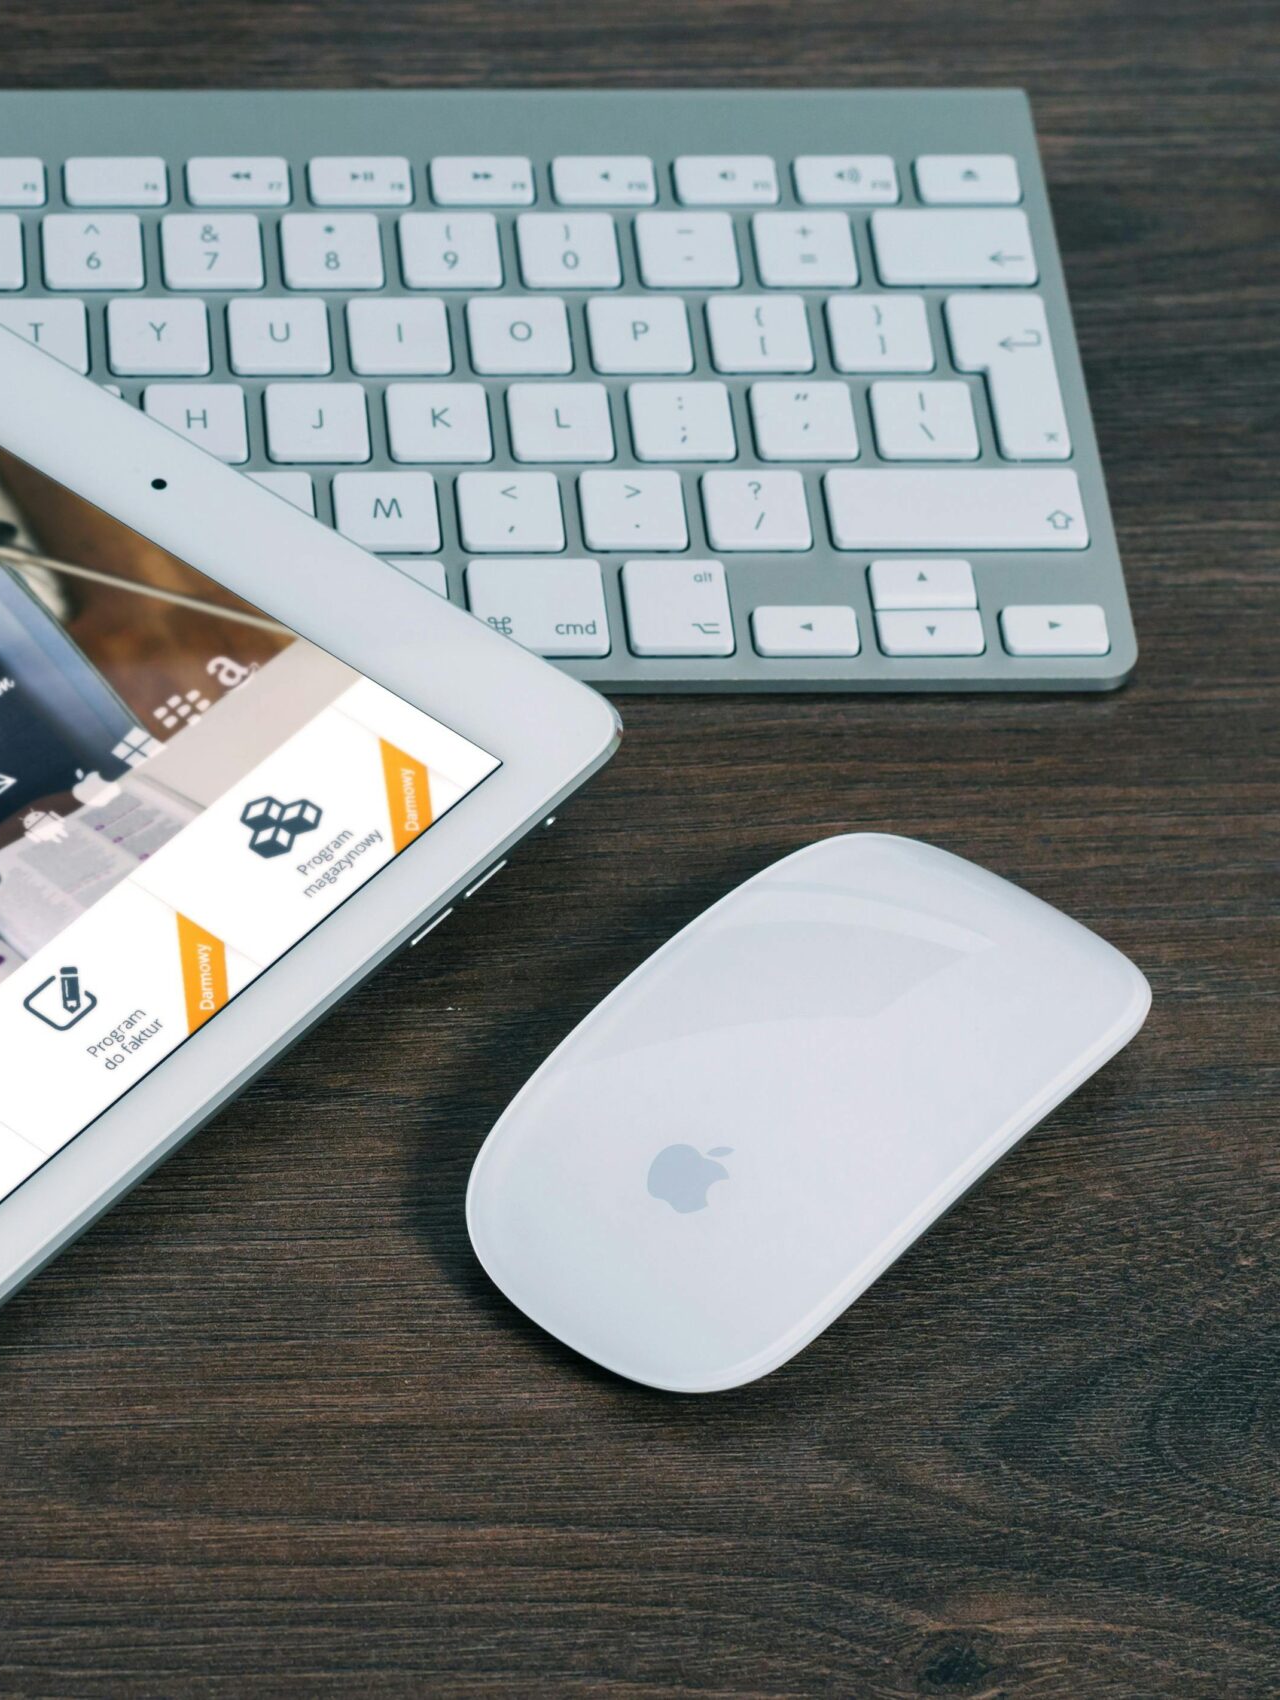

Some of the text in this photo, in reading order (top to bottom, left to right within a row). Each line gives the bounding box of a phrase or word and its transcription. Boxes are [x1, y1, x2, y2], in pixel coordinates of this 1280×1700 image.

[200, 225, 219, 243] &
[86, 252, 101, 269] 6
[204, 252, 219, 270] 7
[325, 251, 340, 270] 8
[443, 251, 458, 269] 9
[562, 250, 579, 270] 0
[29, 323, 43, 342] T
[149, 322, 166, 341] Y
[269, 323, 290, 342] U
[509, 321, 532, 341] O
[632, 321, 649, 341] P
[186, 409, 207, 429] H
[312, 409, 323, 429] J
[431, 408, 451, 427] K
[555, 408, 570, 428] L
[748, 481, 762, 500] ?
[373, 498, 402, 518] M
[693, 572, 712, 583] alt
[555, 620, 597, 635] cmd
[400, 767, 420, 832] Darmowy
[296, 828, 354, 876] Program
[303, 828, 384, 898] magazynowy
[197, 943, 216, 1010] Darmowy
[86, 1008, 147, 1058] Program
[104, 1018, 164, 1071] do faktur
